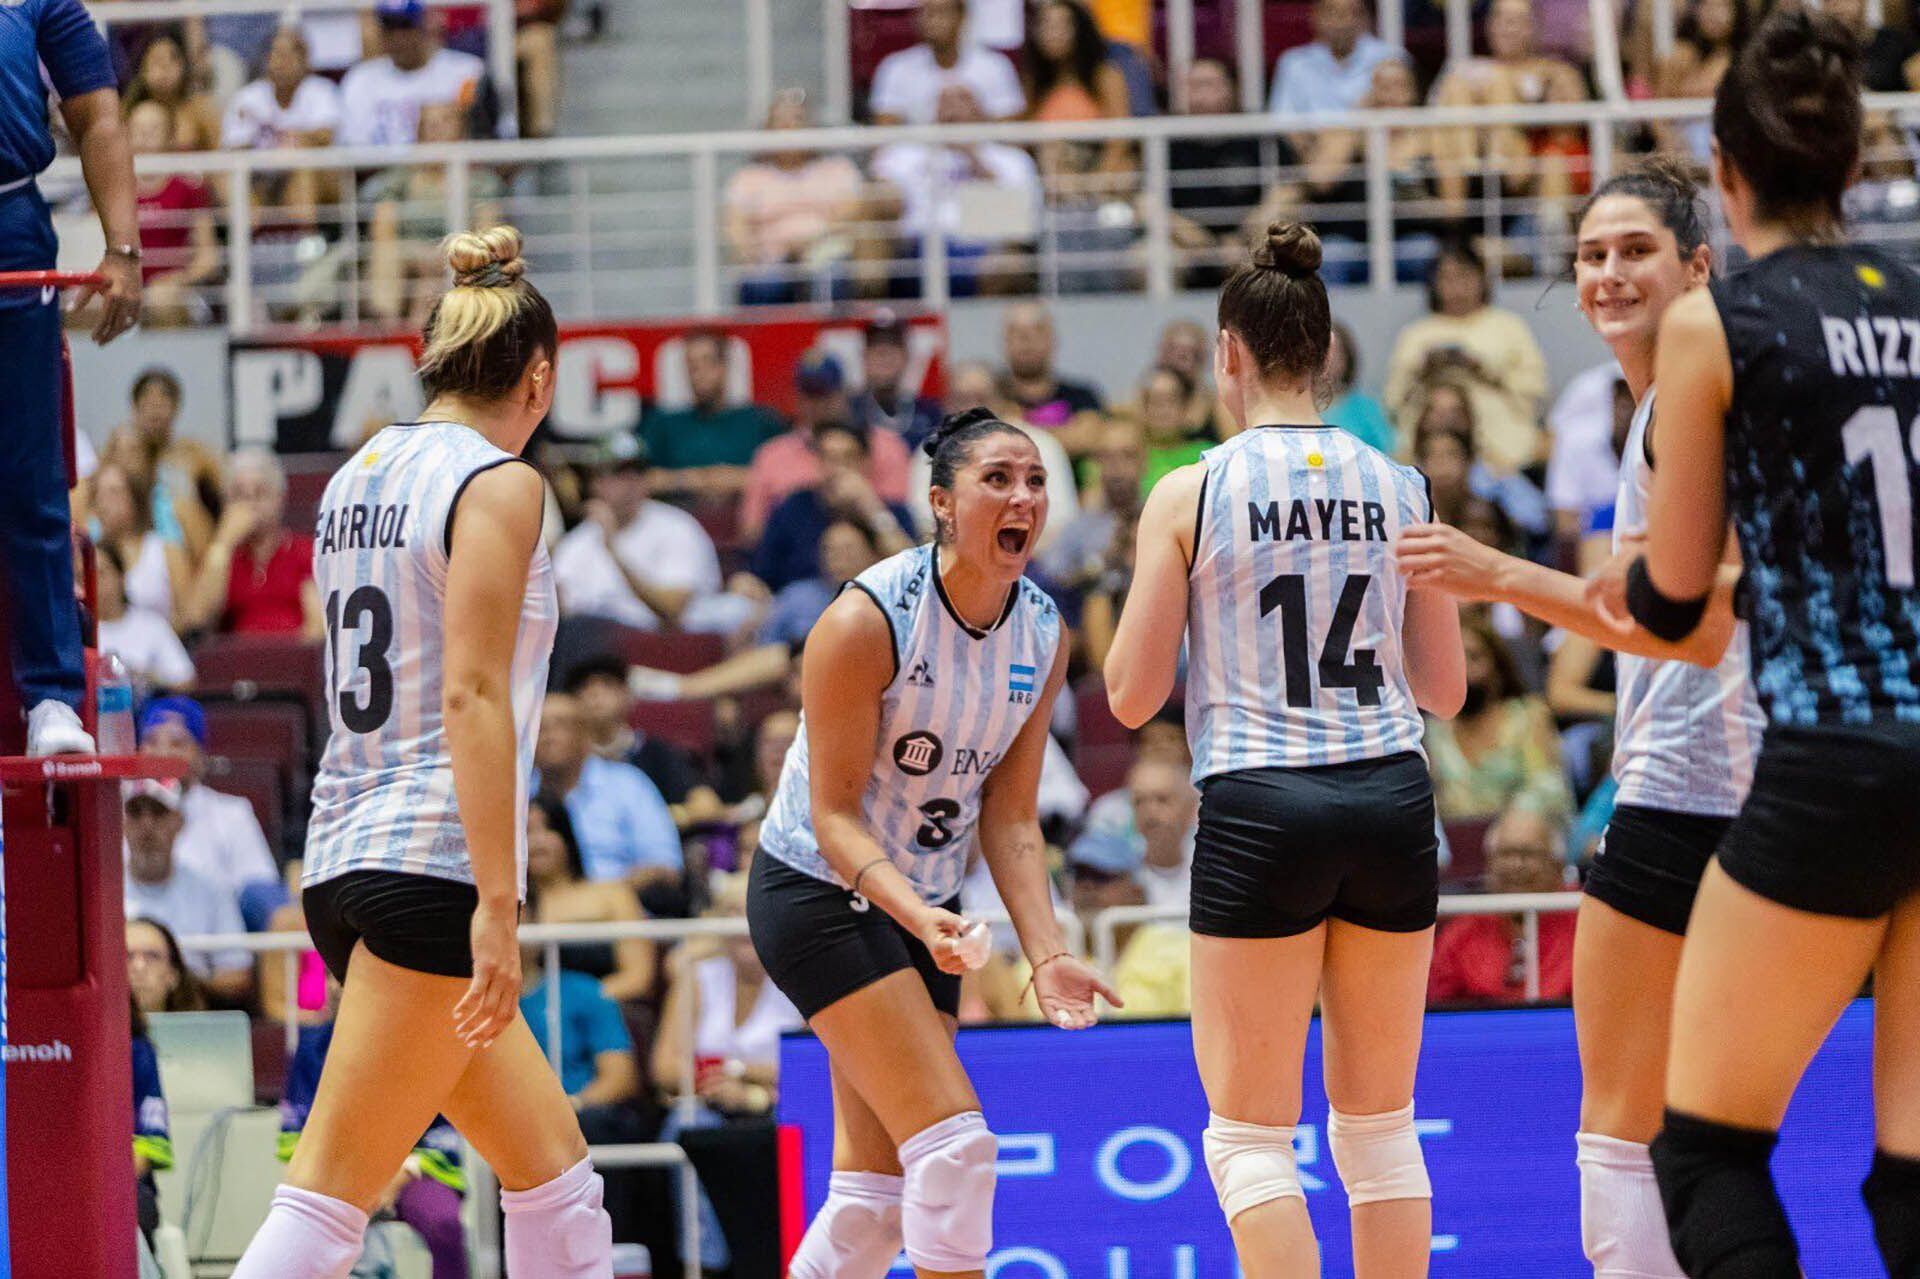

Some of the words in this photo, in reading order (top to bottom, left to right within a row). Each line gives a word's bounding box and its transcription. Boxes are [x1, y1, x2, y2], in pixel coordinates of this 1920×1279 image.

[233, 336, 754, 446] PACO
[1247, 499, 1389, 542] MAYER
[1840, 405, 1920, 588] 1
[326, 585, 394, 735] 13
[1259, 573, 1385, 708] 14
[1008, 691, 1033, 705] ARG
[916, 798, 961, 848] 3
